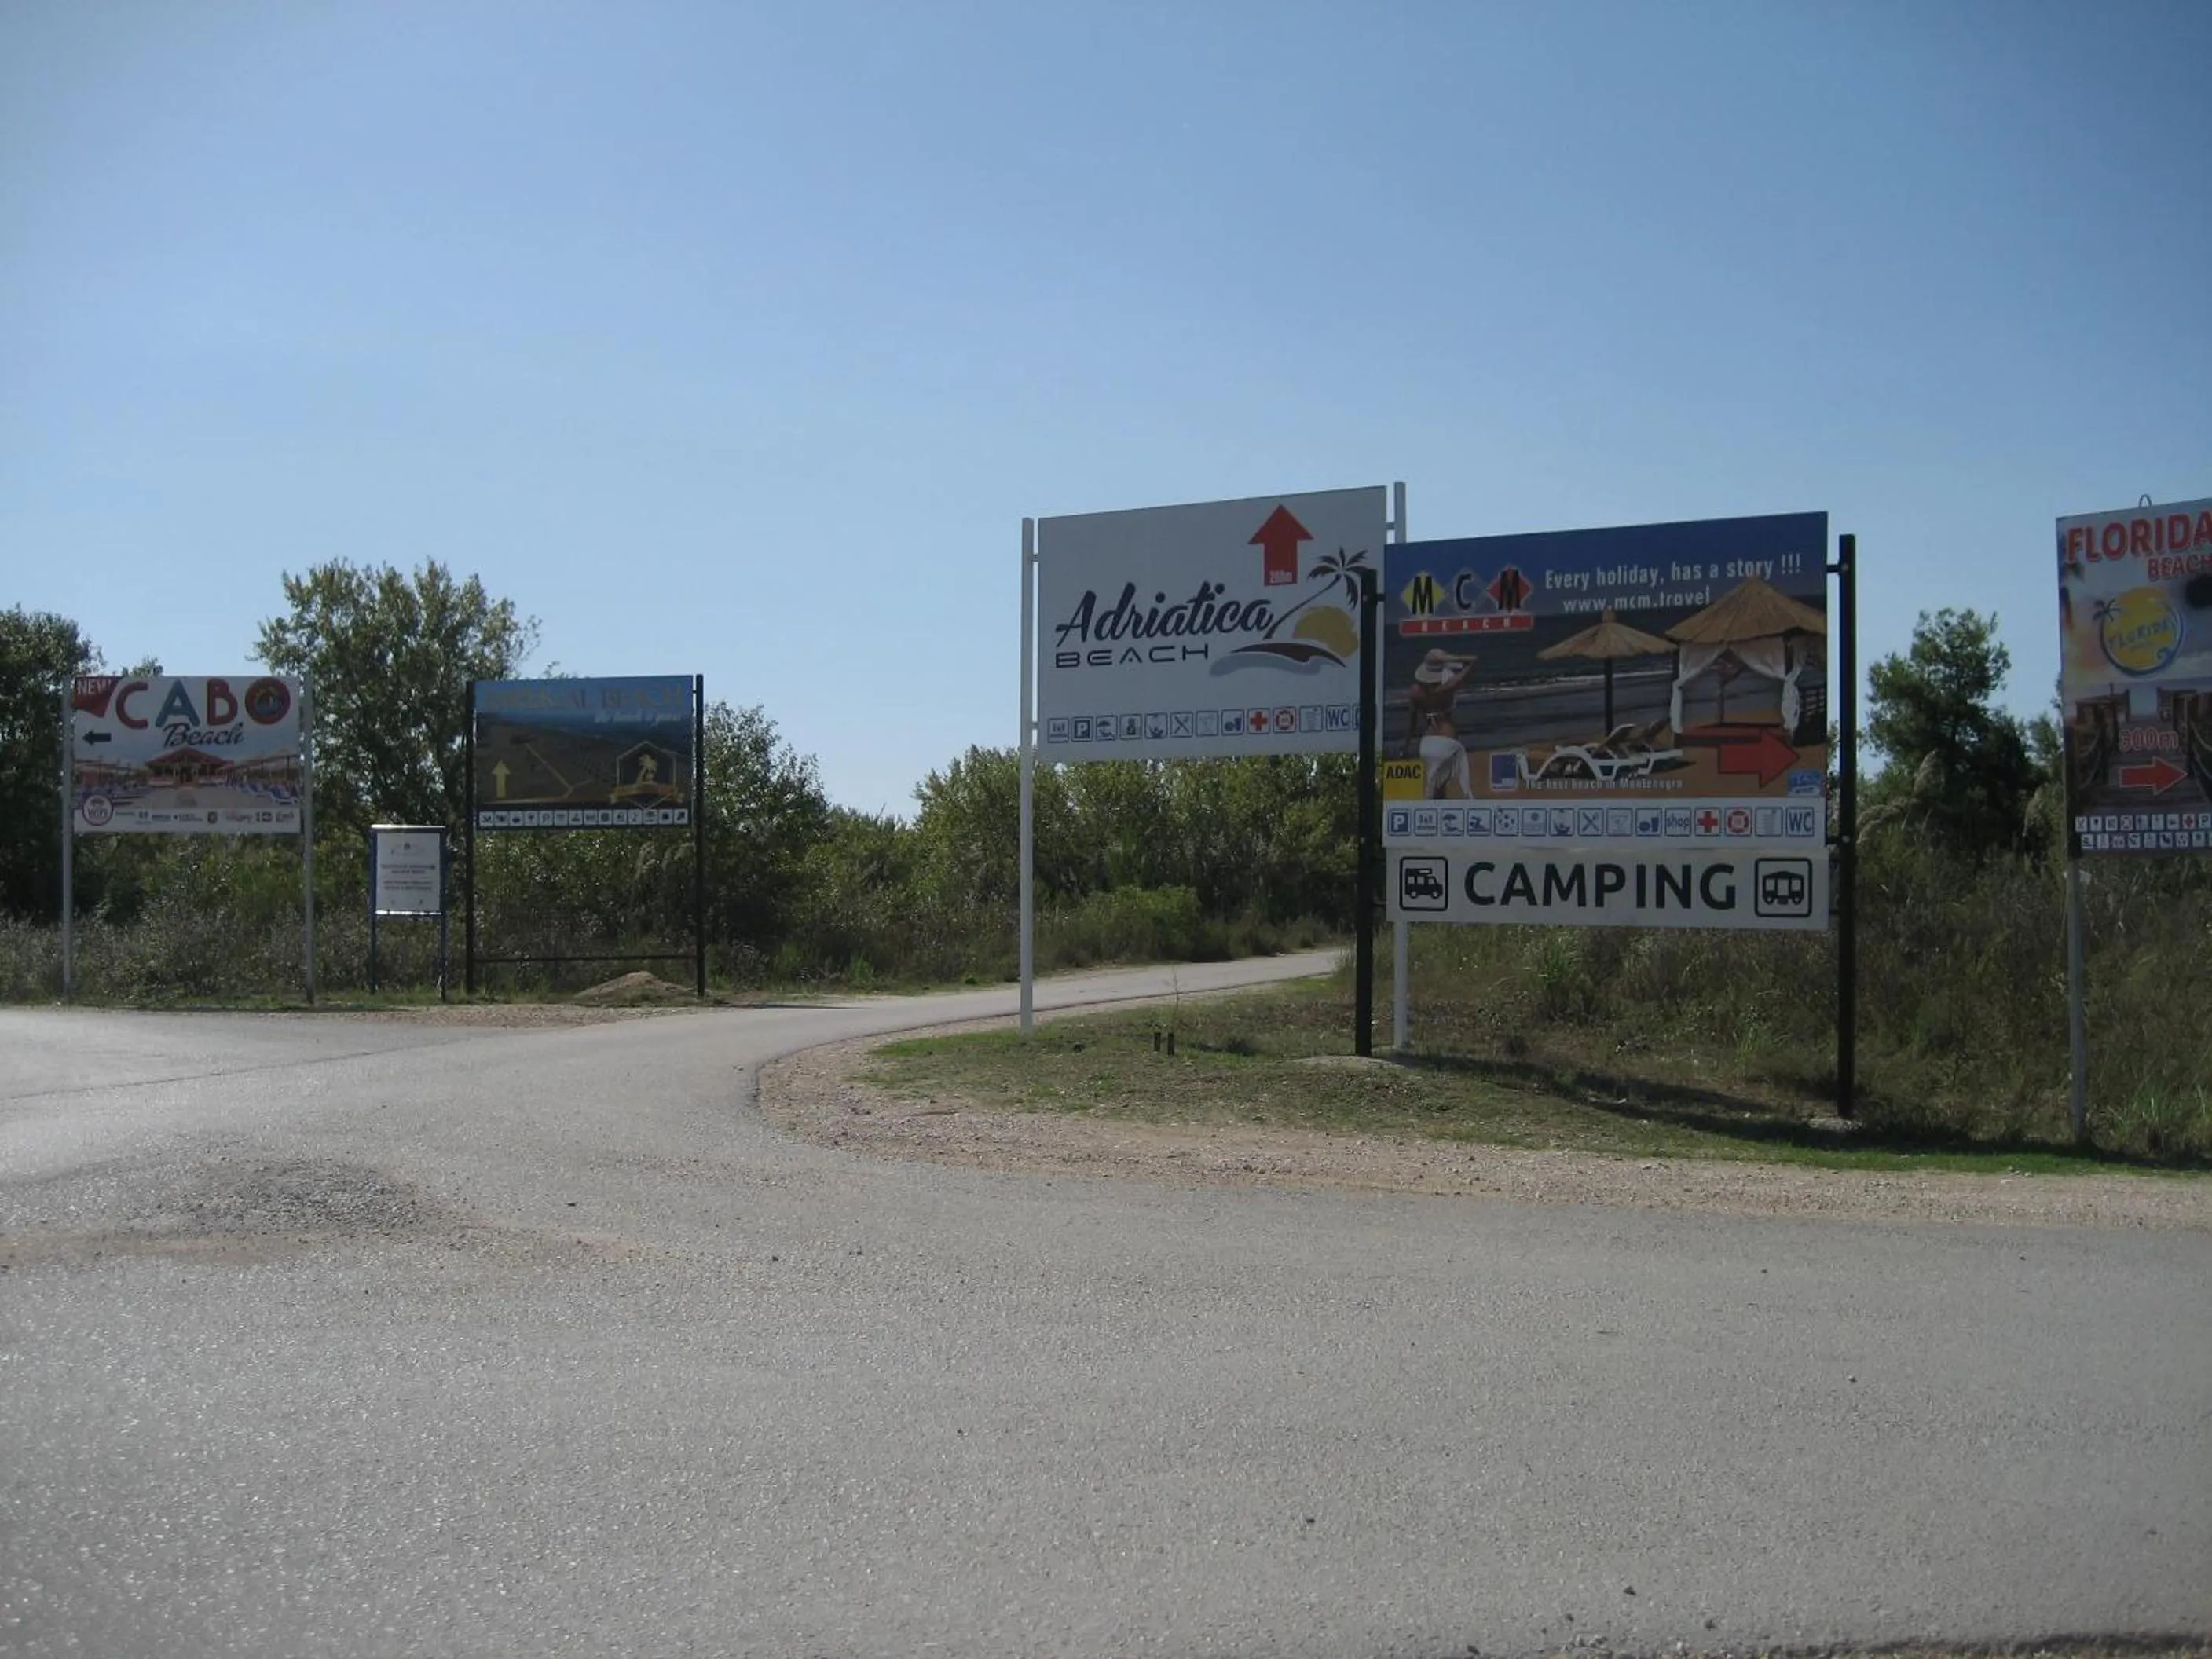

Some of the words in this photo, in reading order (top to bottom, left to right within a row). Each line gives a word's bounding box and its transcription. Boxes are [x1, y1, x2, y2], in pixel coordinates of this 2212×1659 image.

[2067, 511, 2212, 562] FLORIDA
[1544, 569, 1590, 591] Every
[1595, 564, 1664, 588] holiday,
[1671, 561, 1702, 581] has
[1708, 563, 1719, 579] a
[1727, 557, 1774, 581] story
[1780, 553, 1801, 574] !!!
[1562, 585, 1711, 613] www.mcm.travel
[1055, 580, 1273, 647] Adriatica
[1055, 642, 1209, 668] BEACH
[115, 677, 291, 730] CABO
[1328, 709, 1349, 727] WC
[163, 722, 245, 748] Beach
[1386, 764, 1422, 780] ADAC
[1620, 778, 1684, 791] Montenegro
[1665, 810, 1690, 830] shop
[1788, 811, 1812, 833] WC
[1463, 862, 1737, 911] CAMPING
